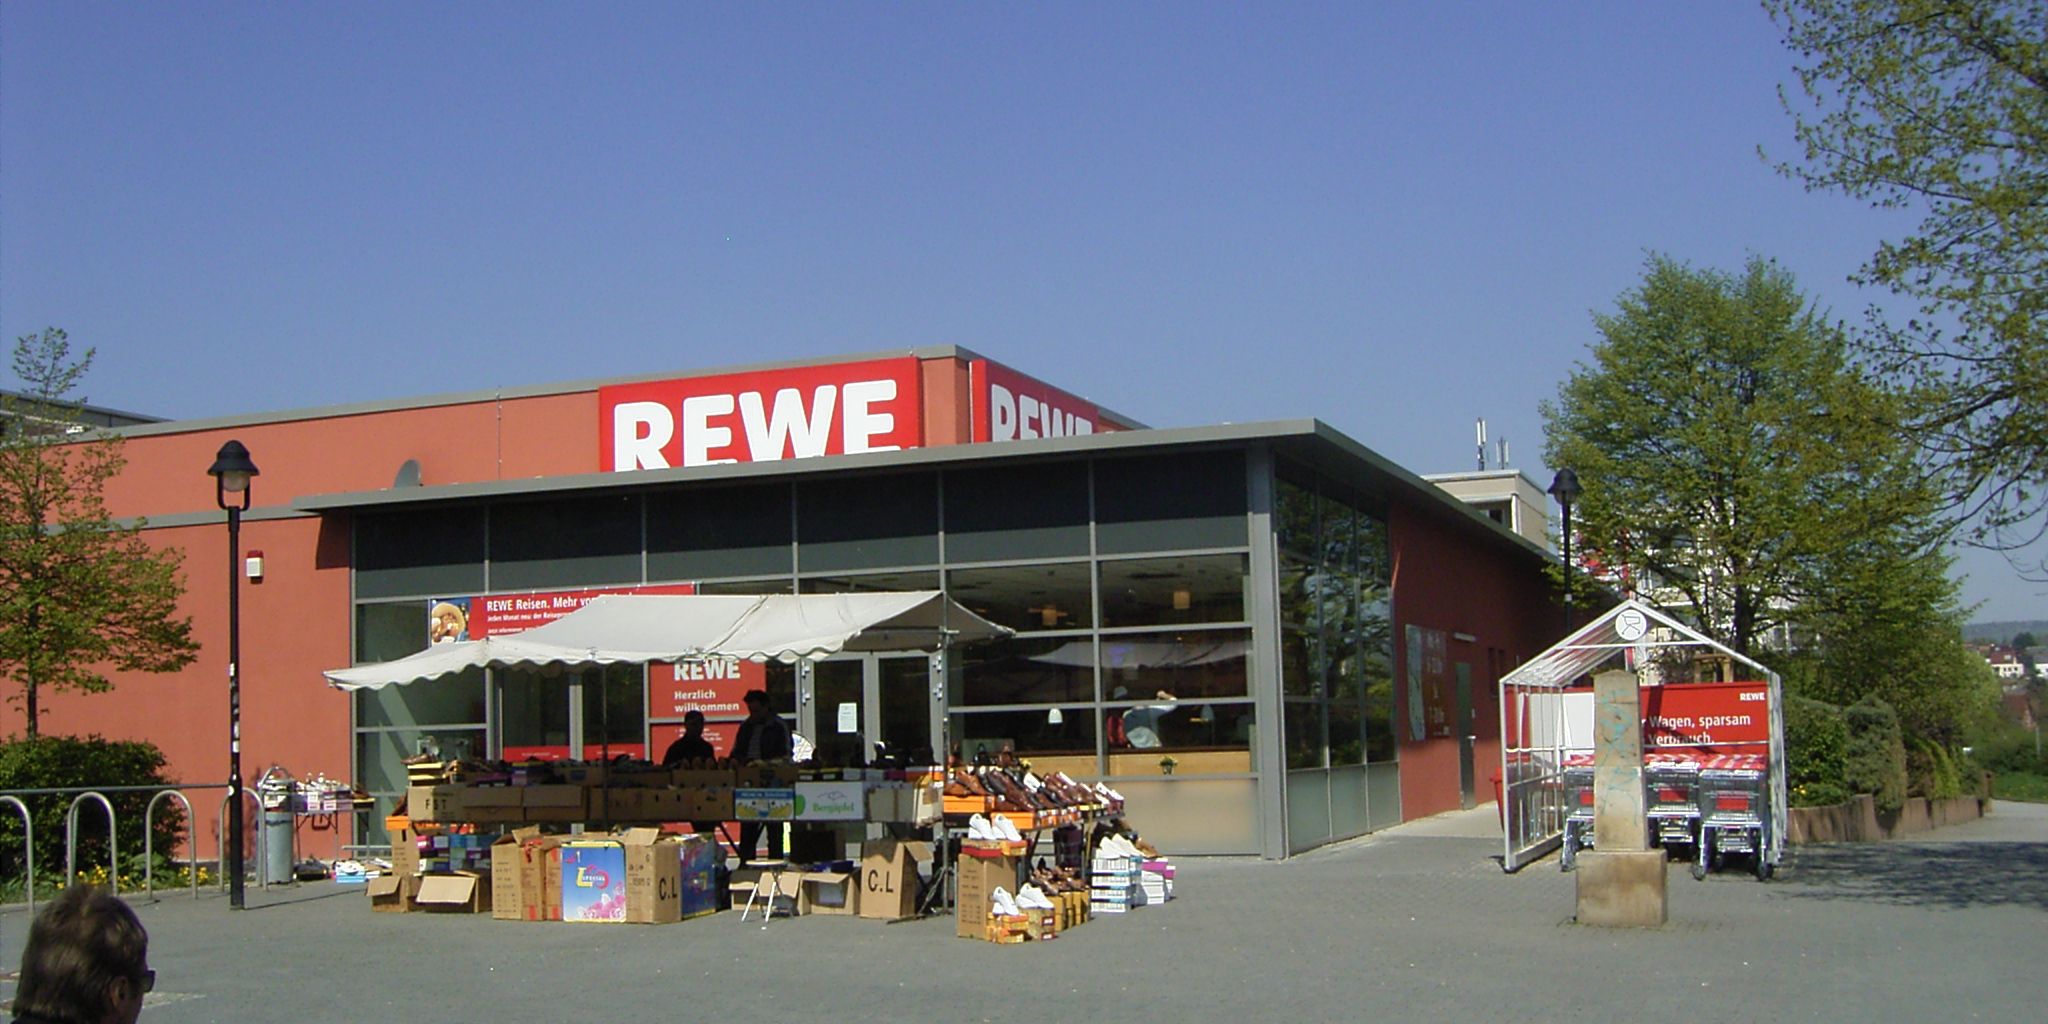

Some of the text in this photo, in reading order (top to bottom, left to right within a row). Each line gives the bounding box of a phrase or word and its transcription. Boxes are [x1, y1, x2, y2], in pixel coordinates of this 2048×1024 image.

[614, 380, 902, 472] REWE
[486, 600, 513, 612] REWE
[515, 599, 551, 610] Reisen.
[553, 596, 577, 608] Mehr
[674, 659, 741, 681] REWE
[674, 689, 716, 700] Herzlich
[1739, 692, 1765, 701] REWE
[674, 701, 740, 712] willkommen
[1649, 715, 1695, 730] Wagen,
[1698, 715, 1751, 729] sparsam
[868, 869, 894, 893] C.L
